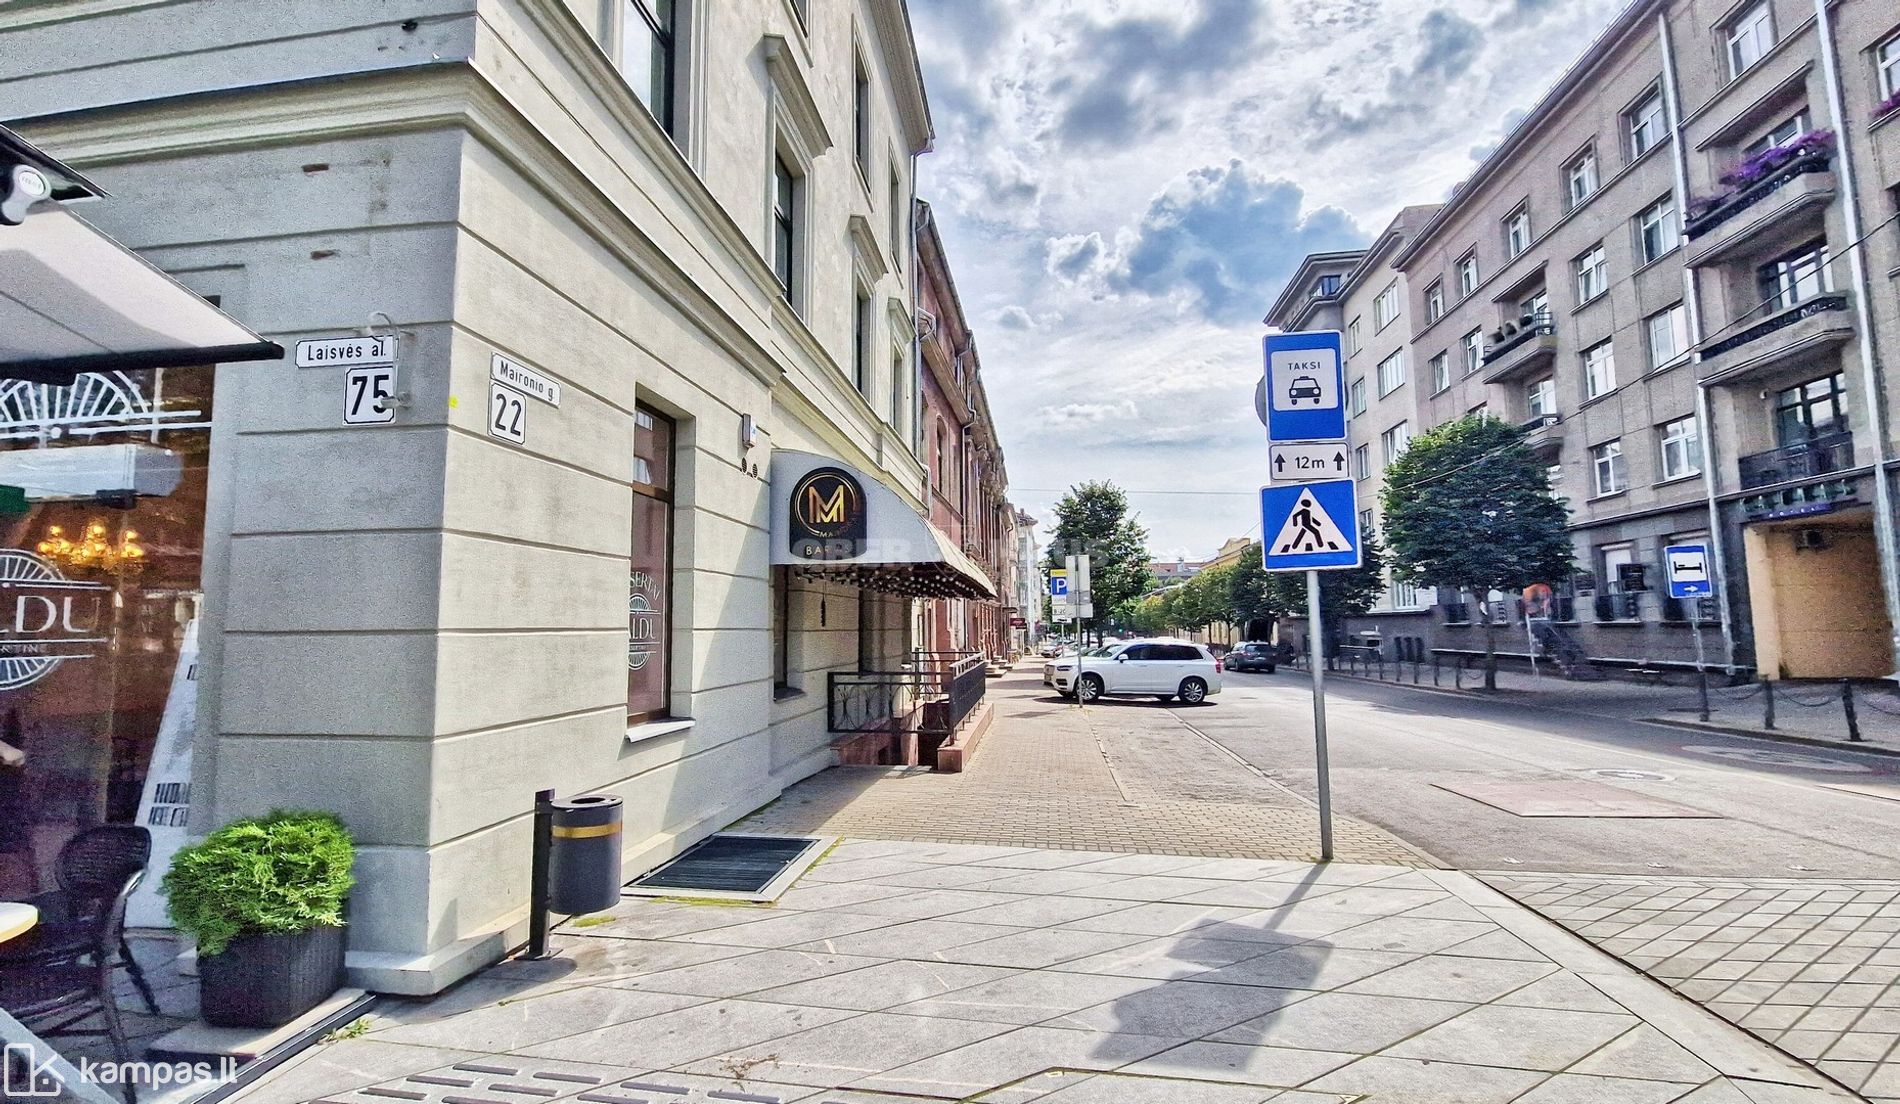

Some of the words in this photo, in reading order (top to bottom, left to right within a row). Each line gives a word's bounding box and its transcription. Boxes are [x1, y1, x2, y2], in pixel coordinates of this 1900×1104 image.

[307, 343, 363, 361] Laisvės
[371, 341, 386, 357] al.
[500, 360, 544, 394] Maironio
[1287, 361, 1321, 371] TAKSI
[351, 374, 390, 416] 75
[494, 393, 522, 437] 22
[1056, 578, 1067, 593] P
